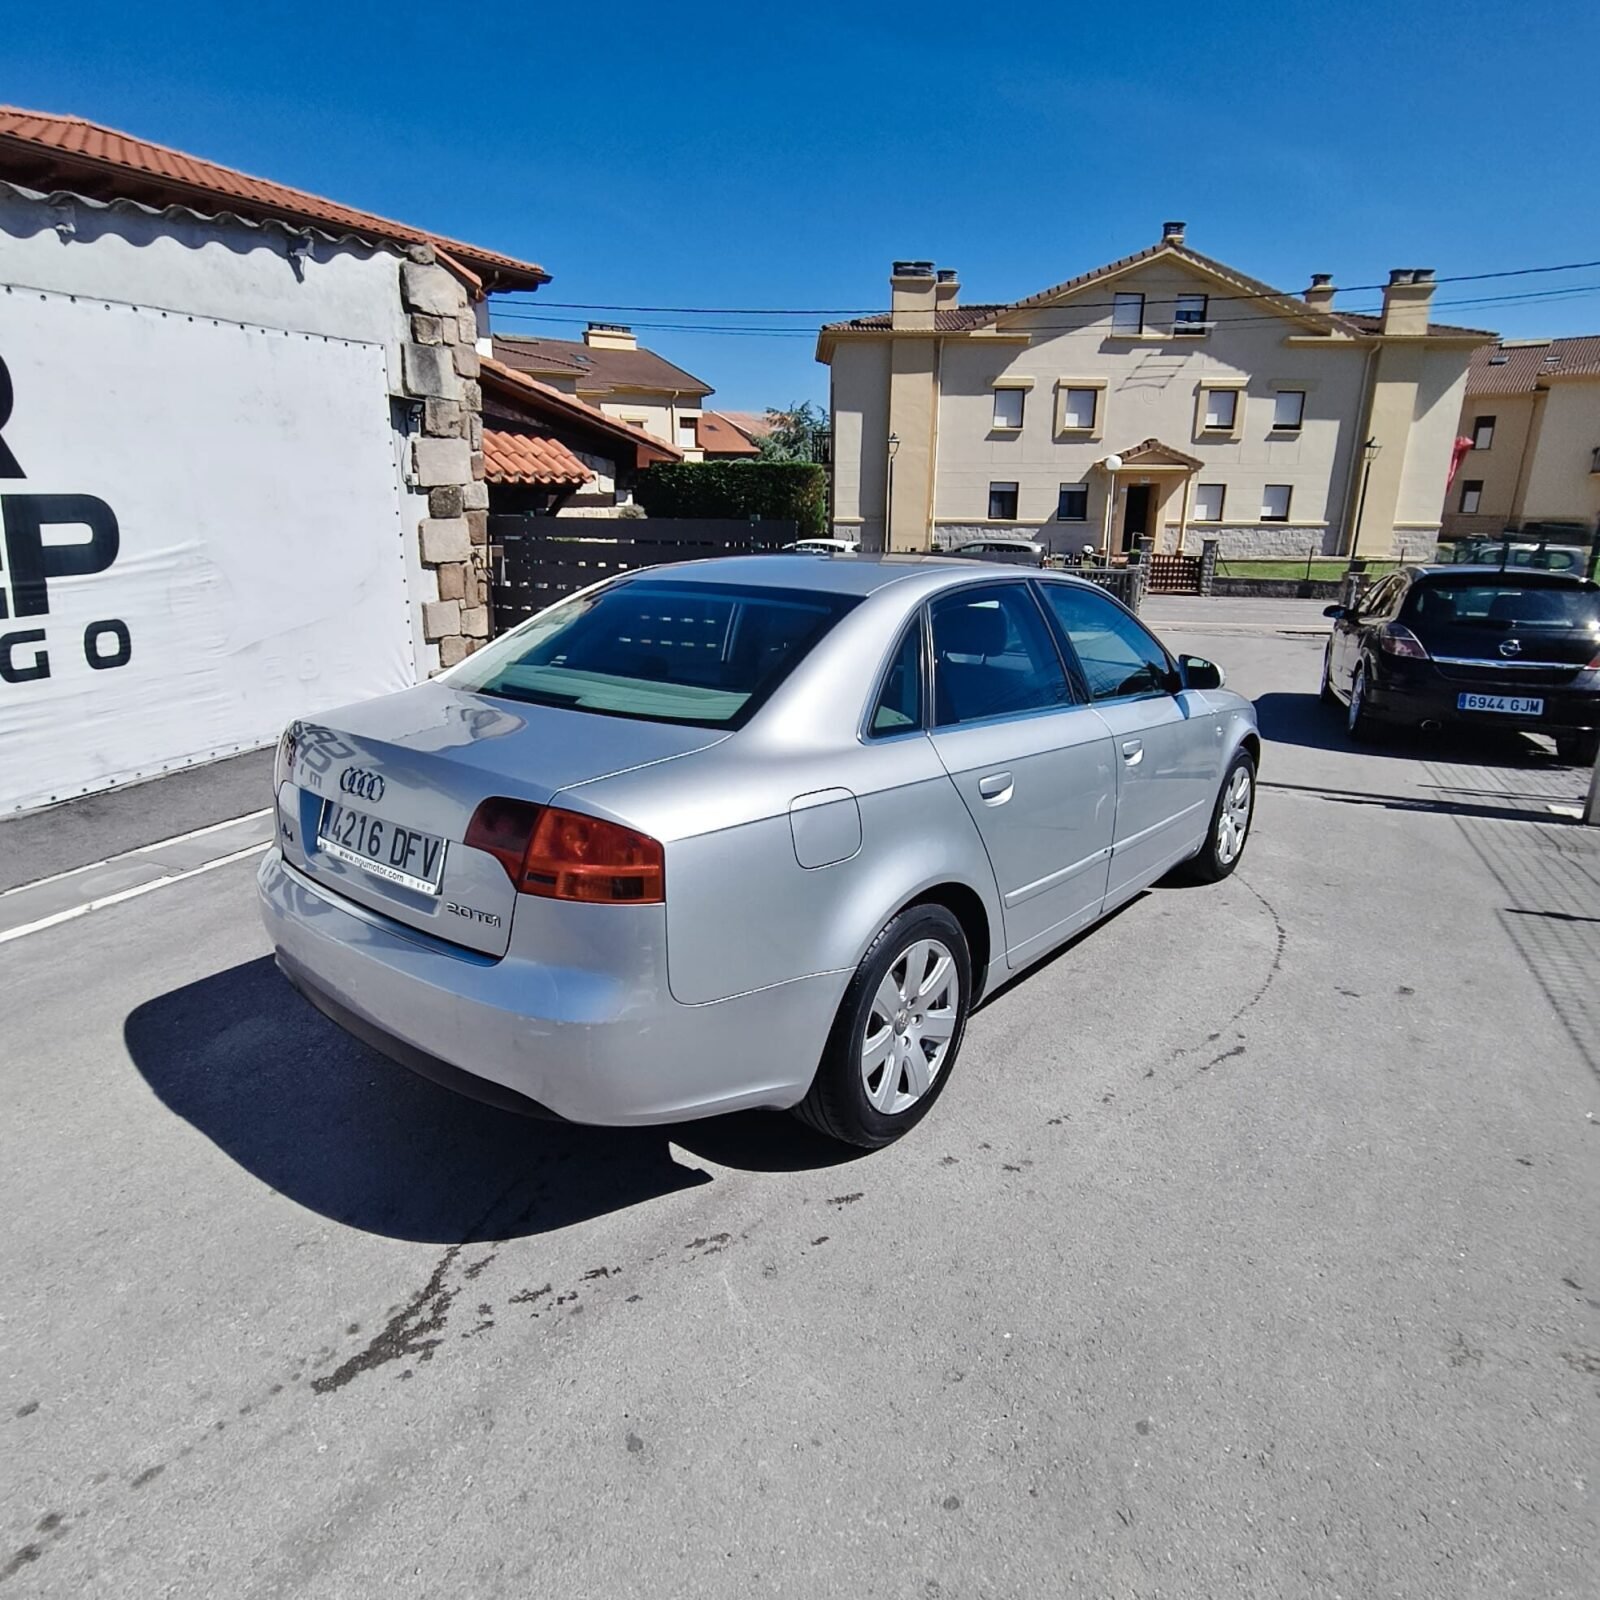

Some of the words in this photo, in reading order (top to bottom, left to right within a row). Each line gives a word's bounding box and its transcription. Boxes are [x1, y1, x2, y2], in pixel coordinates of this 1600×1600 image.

[1468, 695, 1505, 710] 6944
[1510, 699, 1540, 713] GJM
[331, 806, 384, 857] 4216
[389, 826, 440, 878] DFV
